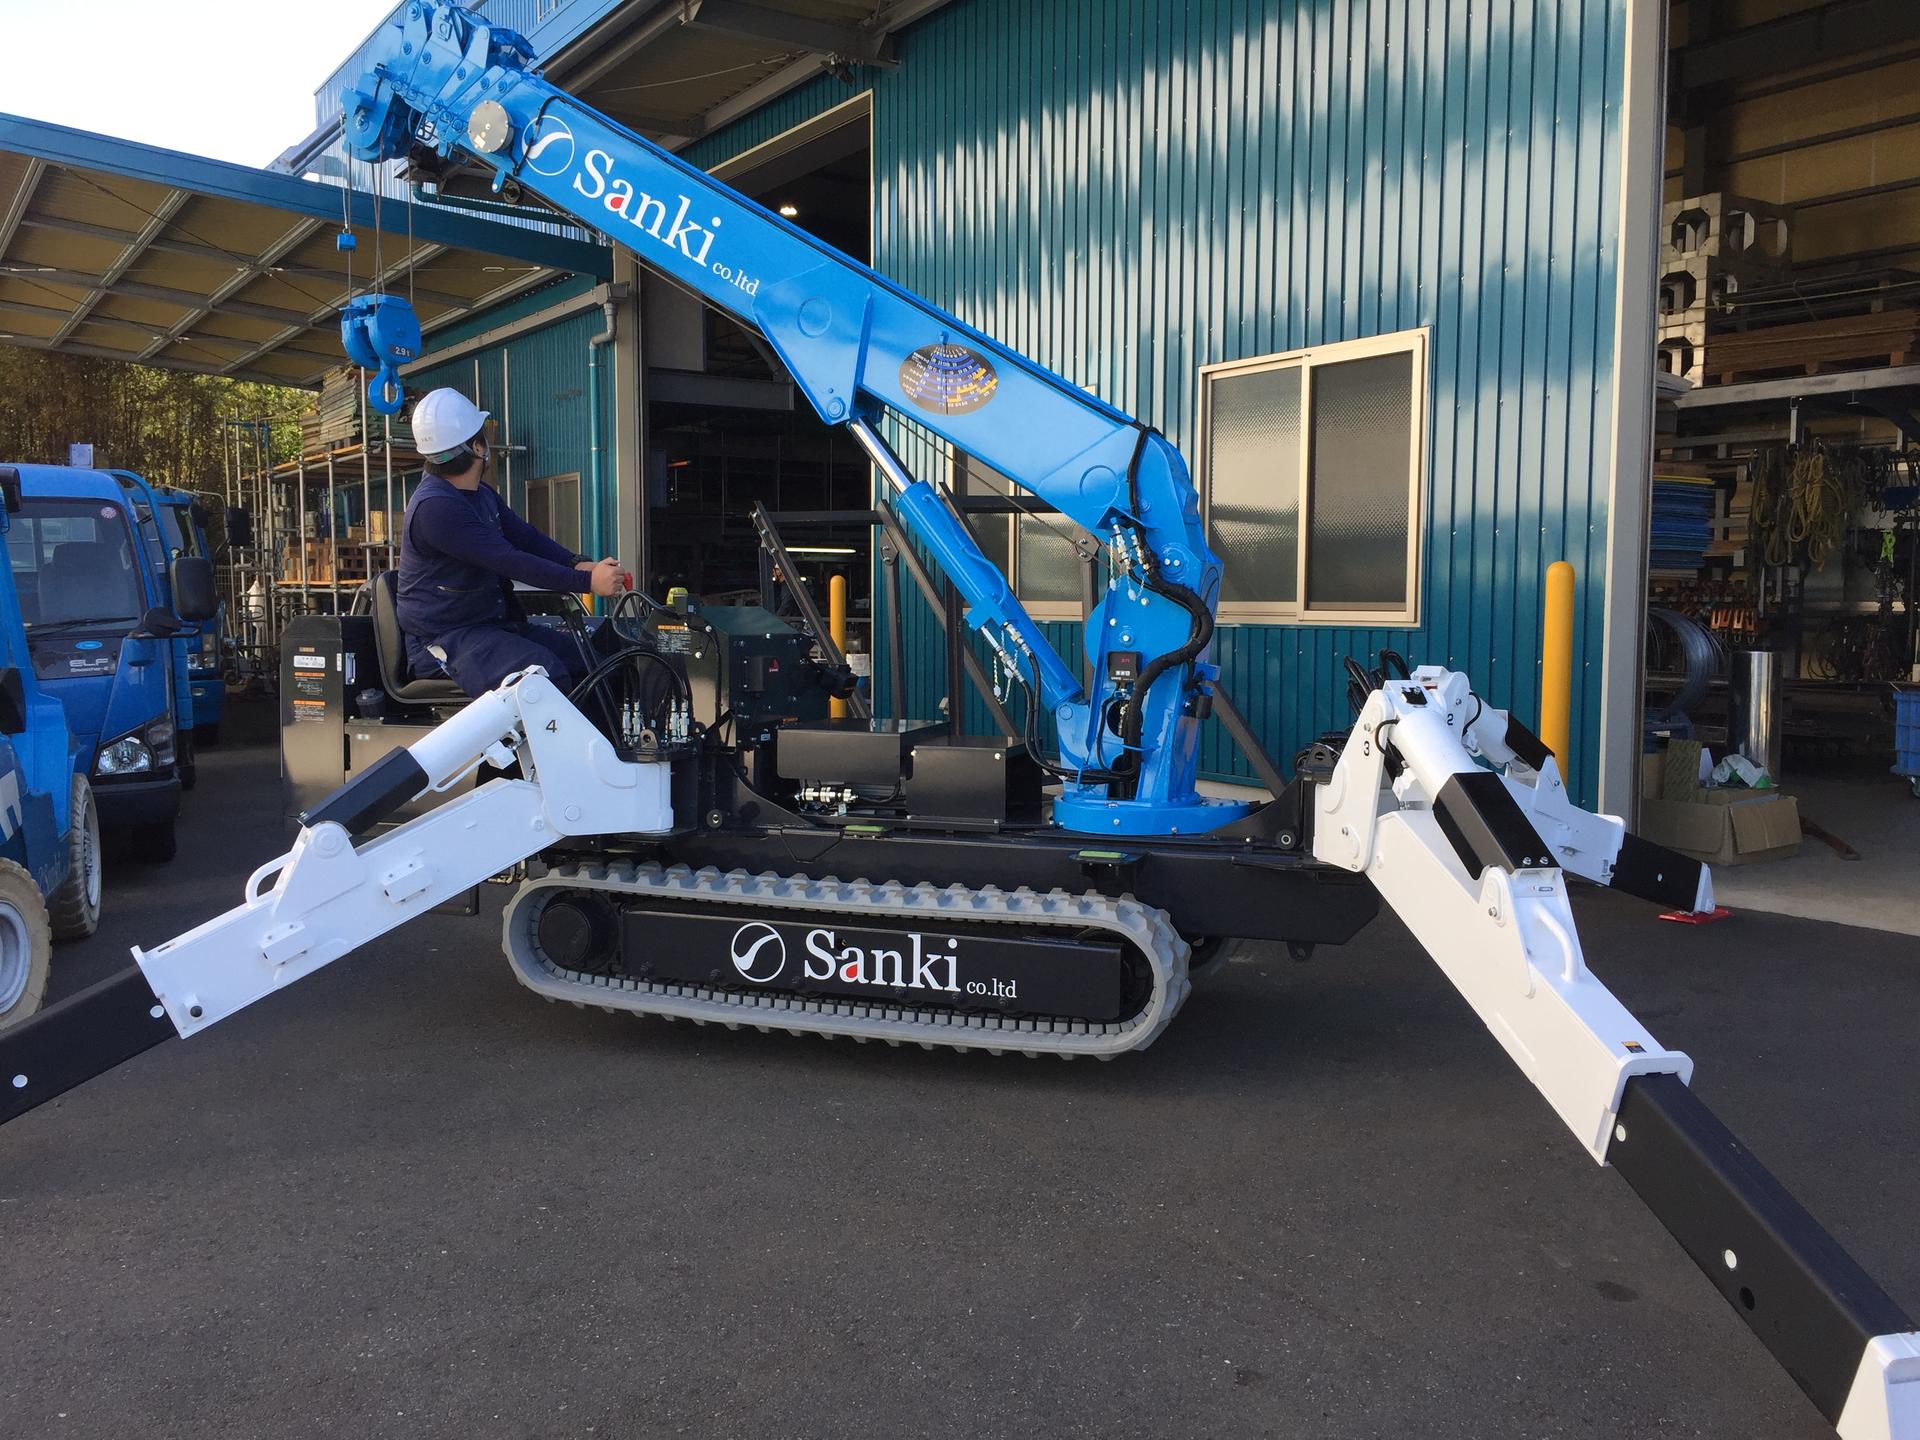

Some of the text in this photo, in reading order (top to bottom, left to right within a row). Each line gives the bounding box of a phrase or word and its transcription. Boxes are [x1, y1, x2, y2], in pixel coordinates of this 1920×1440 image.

[572, 149, 760, 297] Sanki co.ltd
[69, 658, 109, 667] ELF
[546, 719, 558, 733] 4
[1446, 713, 1454, 726] 2
[1363, 740, 1370, 757] 3
[804, 928, 1018, 999] Sanki co.ltd
